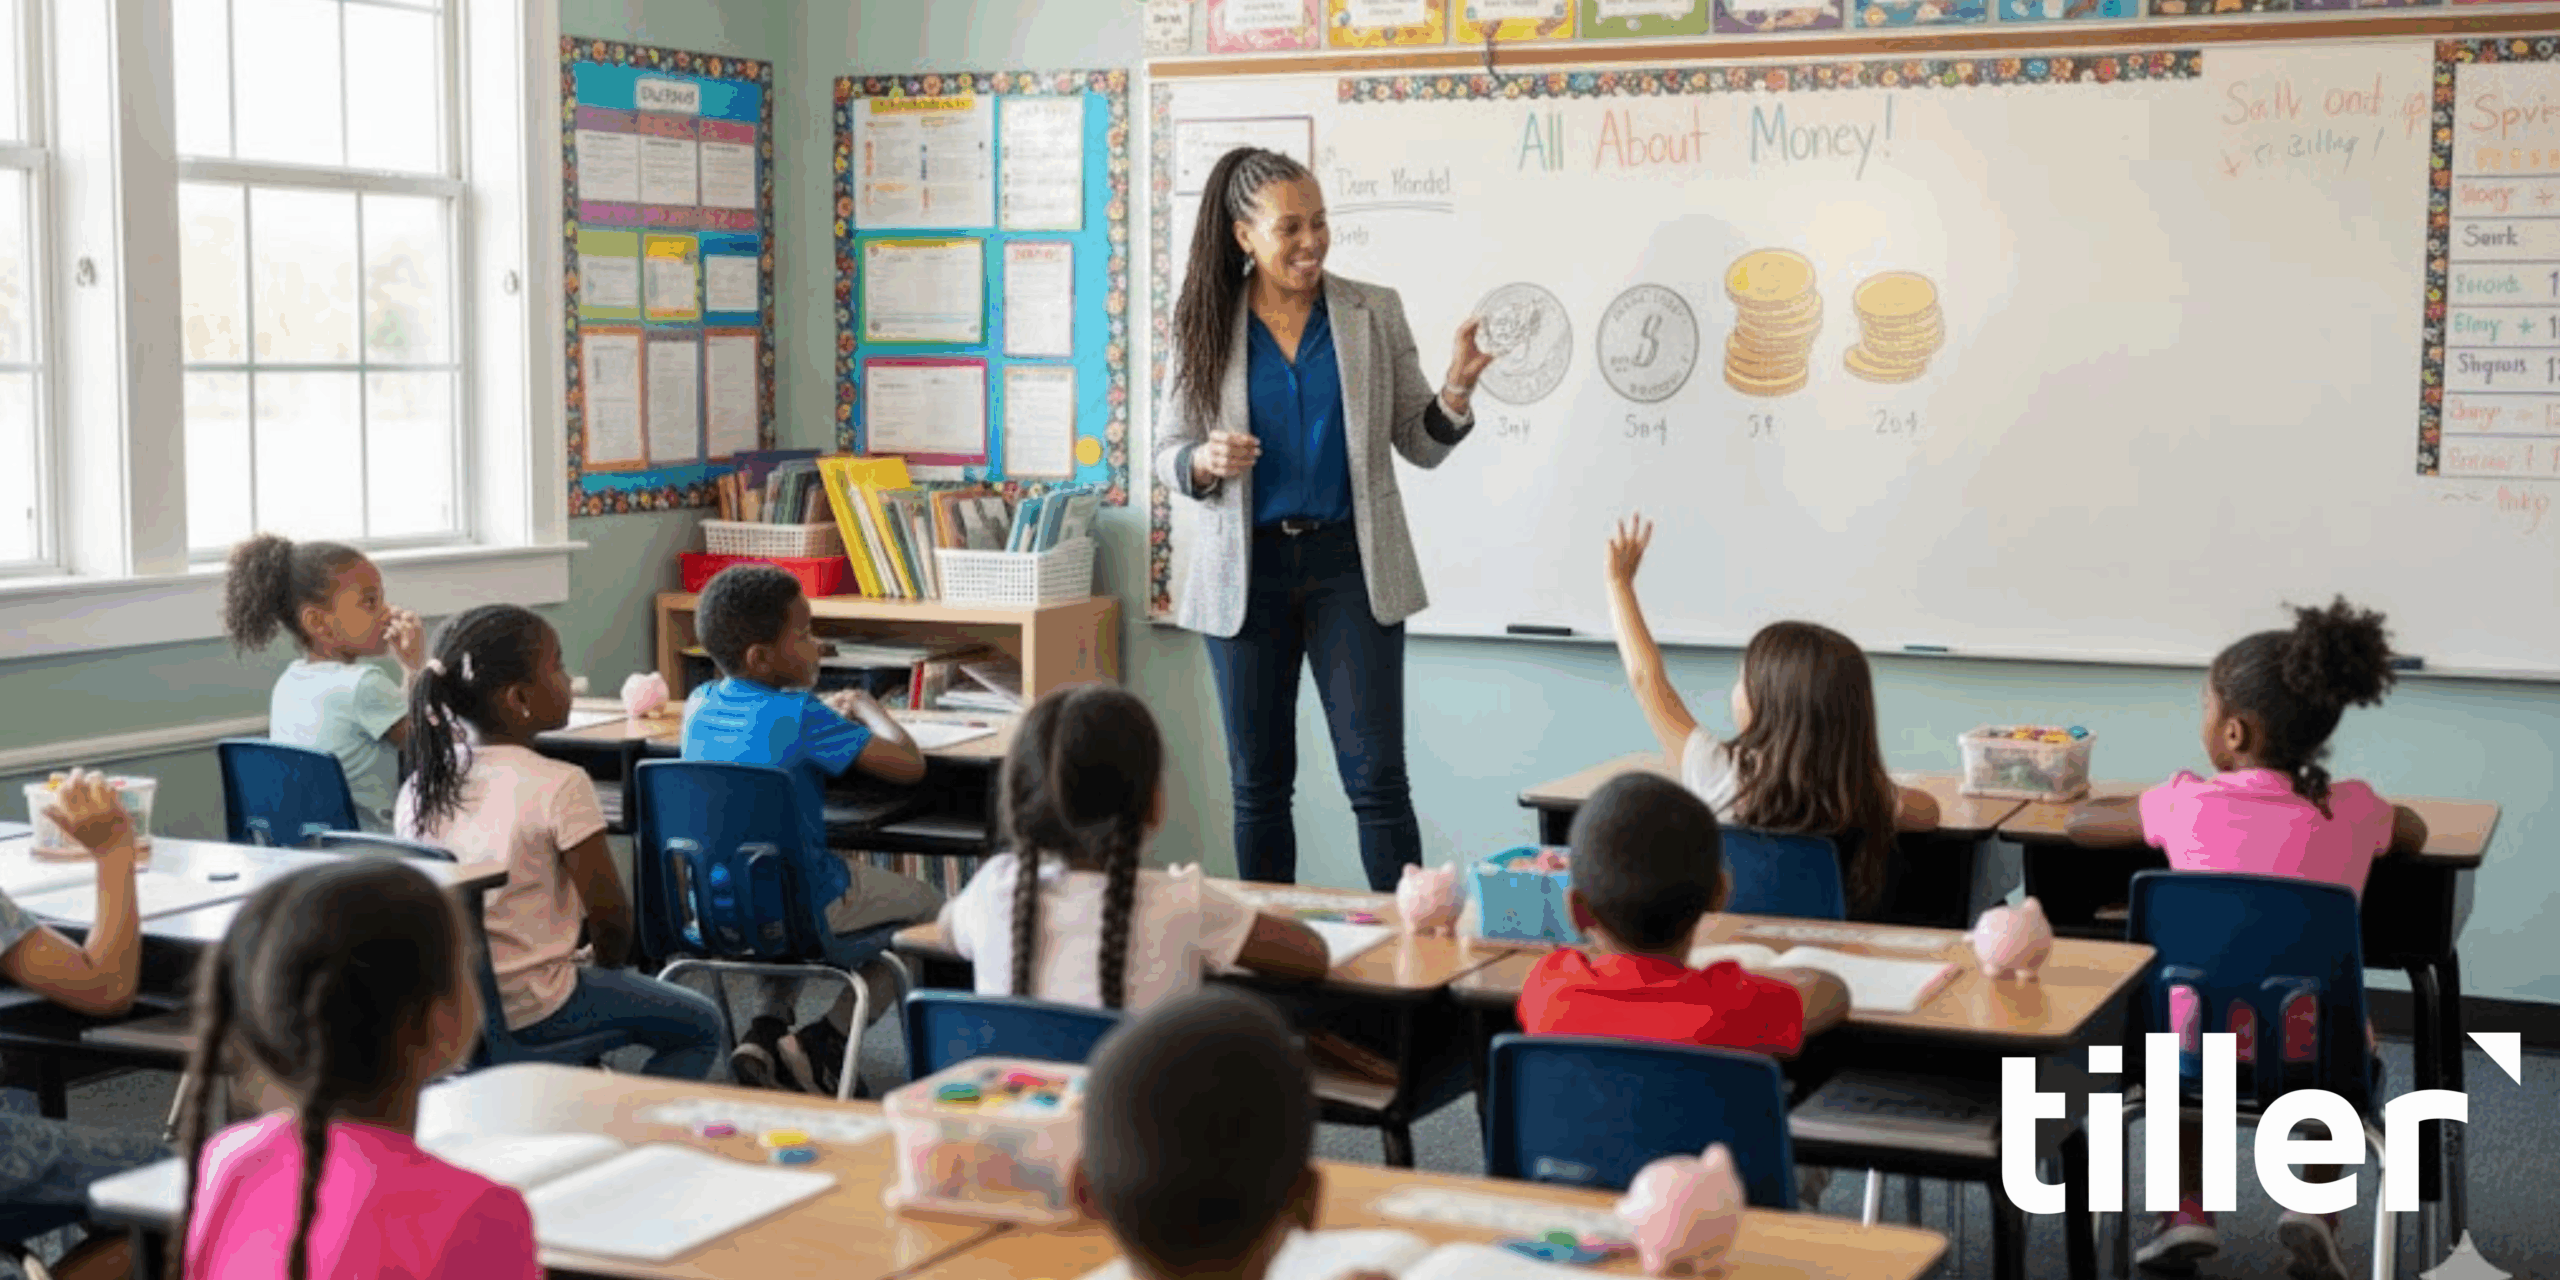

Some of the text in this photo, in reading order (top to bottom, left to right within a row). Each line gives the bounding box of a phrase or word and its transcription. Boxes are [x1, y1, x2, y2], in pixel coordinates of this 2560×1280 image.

[1518, 93, 1894, 182] All About Money!
